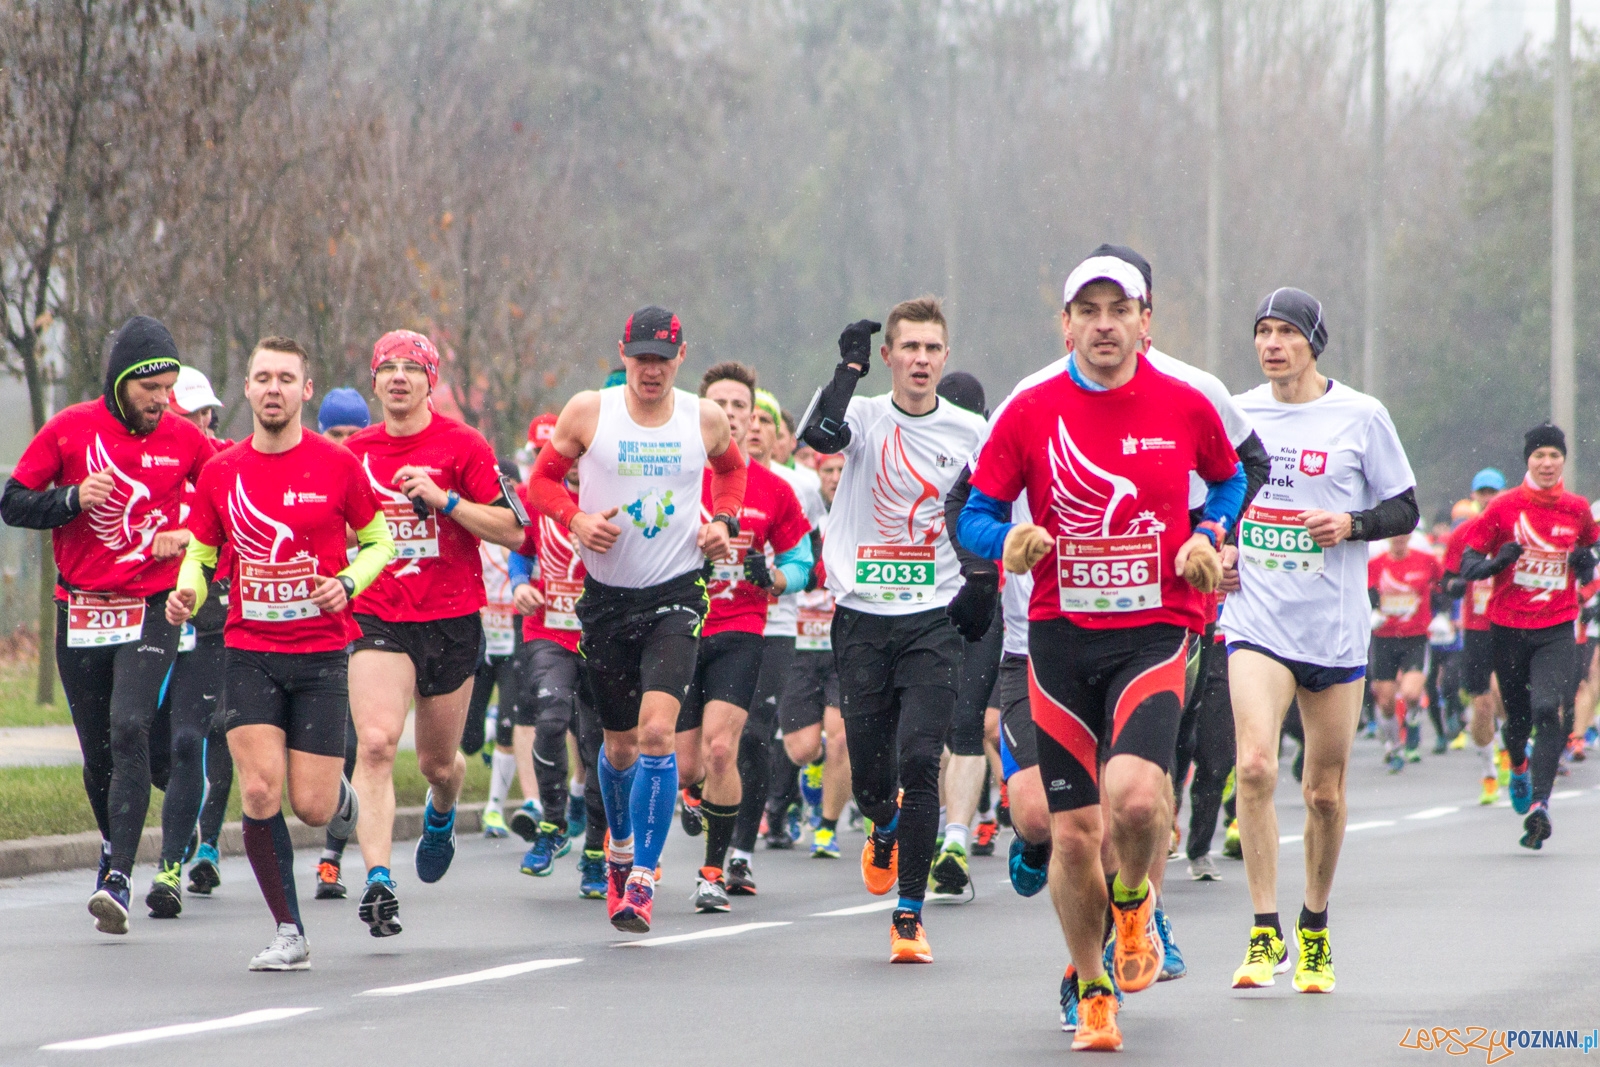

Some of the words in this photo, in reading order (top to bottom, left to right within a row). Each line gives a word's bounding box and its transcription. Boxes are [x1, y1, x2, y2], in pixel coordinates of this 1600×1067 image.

[1269, 453, 1296, 463] egacza
[1281, 447, 1297, 455] Klub
[388, 520, 428, 539] 964
[1250, 526, 1314, 552] 6966
[857, 568, 864, 576] C
[866, 563, 927, 583] 2033
[1061, 569, 1069, 578] B
[1072, 560, 1149, 586] 5656
[1525, 560, 1563, 576] 7123
[249, 580, 309, 602] 7194
[553, 596, 574, 613] 43
[86, 610, 128, 628] 201
